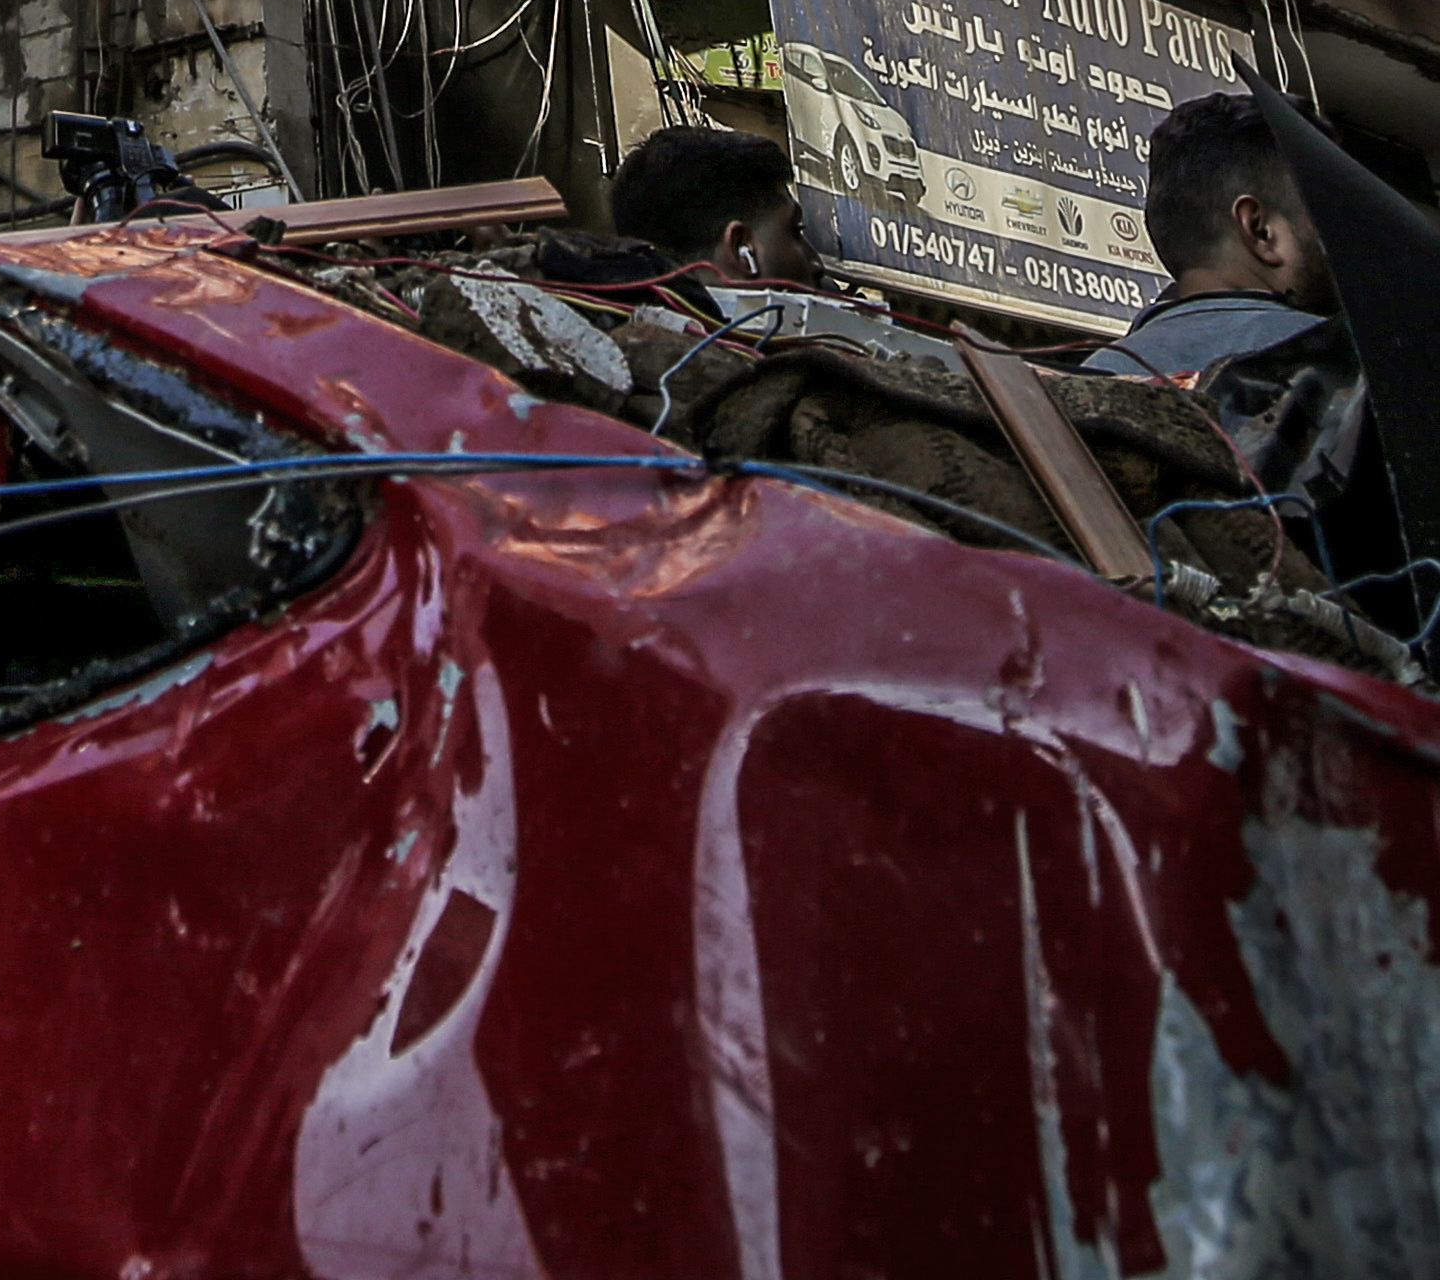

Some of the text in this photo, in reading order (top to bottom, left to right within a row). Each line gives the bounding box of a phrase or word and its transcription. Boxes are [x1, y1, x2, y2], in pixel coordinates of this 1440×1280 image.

[902, 2, 1005, 62] بارتس
[863, 36, 938, 91] الكورية
[944, 70, 1038, 120] السيارات
[1087, 64, 1174, 111] حمود
[1042, 104, 1082, 136] قطع
[1086, 116, 1129, 152] أنواع
[972, 129, 1001, 157] ديزل
[1013, 141, 1043, 170] بنزين
[1115, 216, 1135, 235] KIA
[870, 217, 995, 276] 01/540747
[1024, 256, 1144, 309] 03/138003
